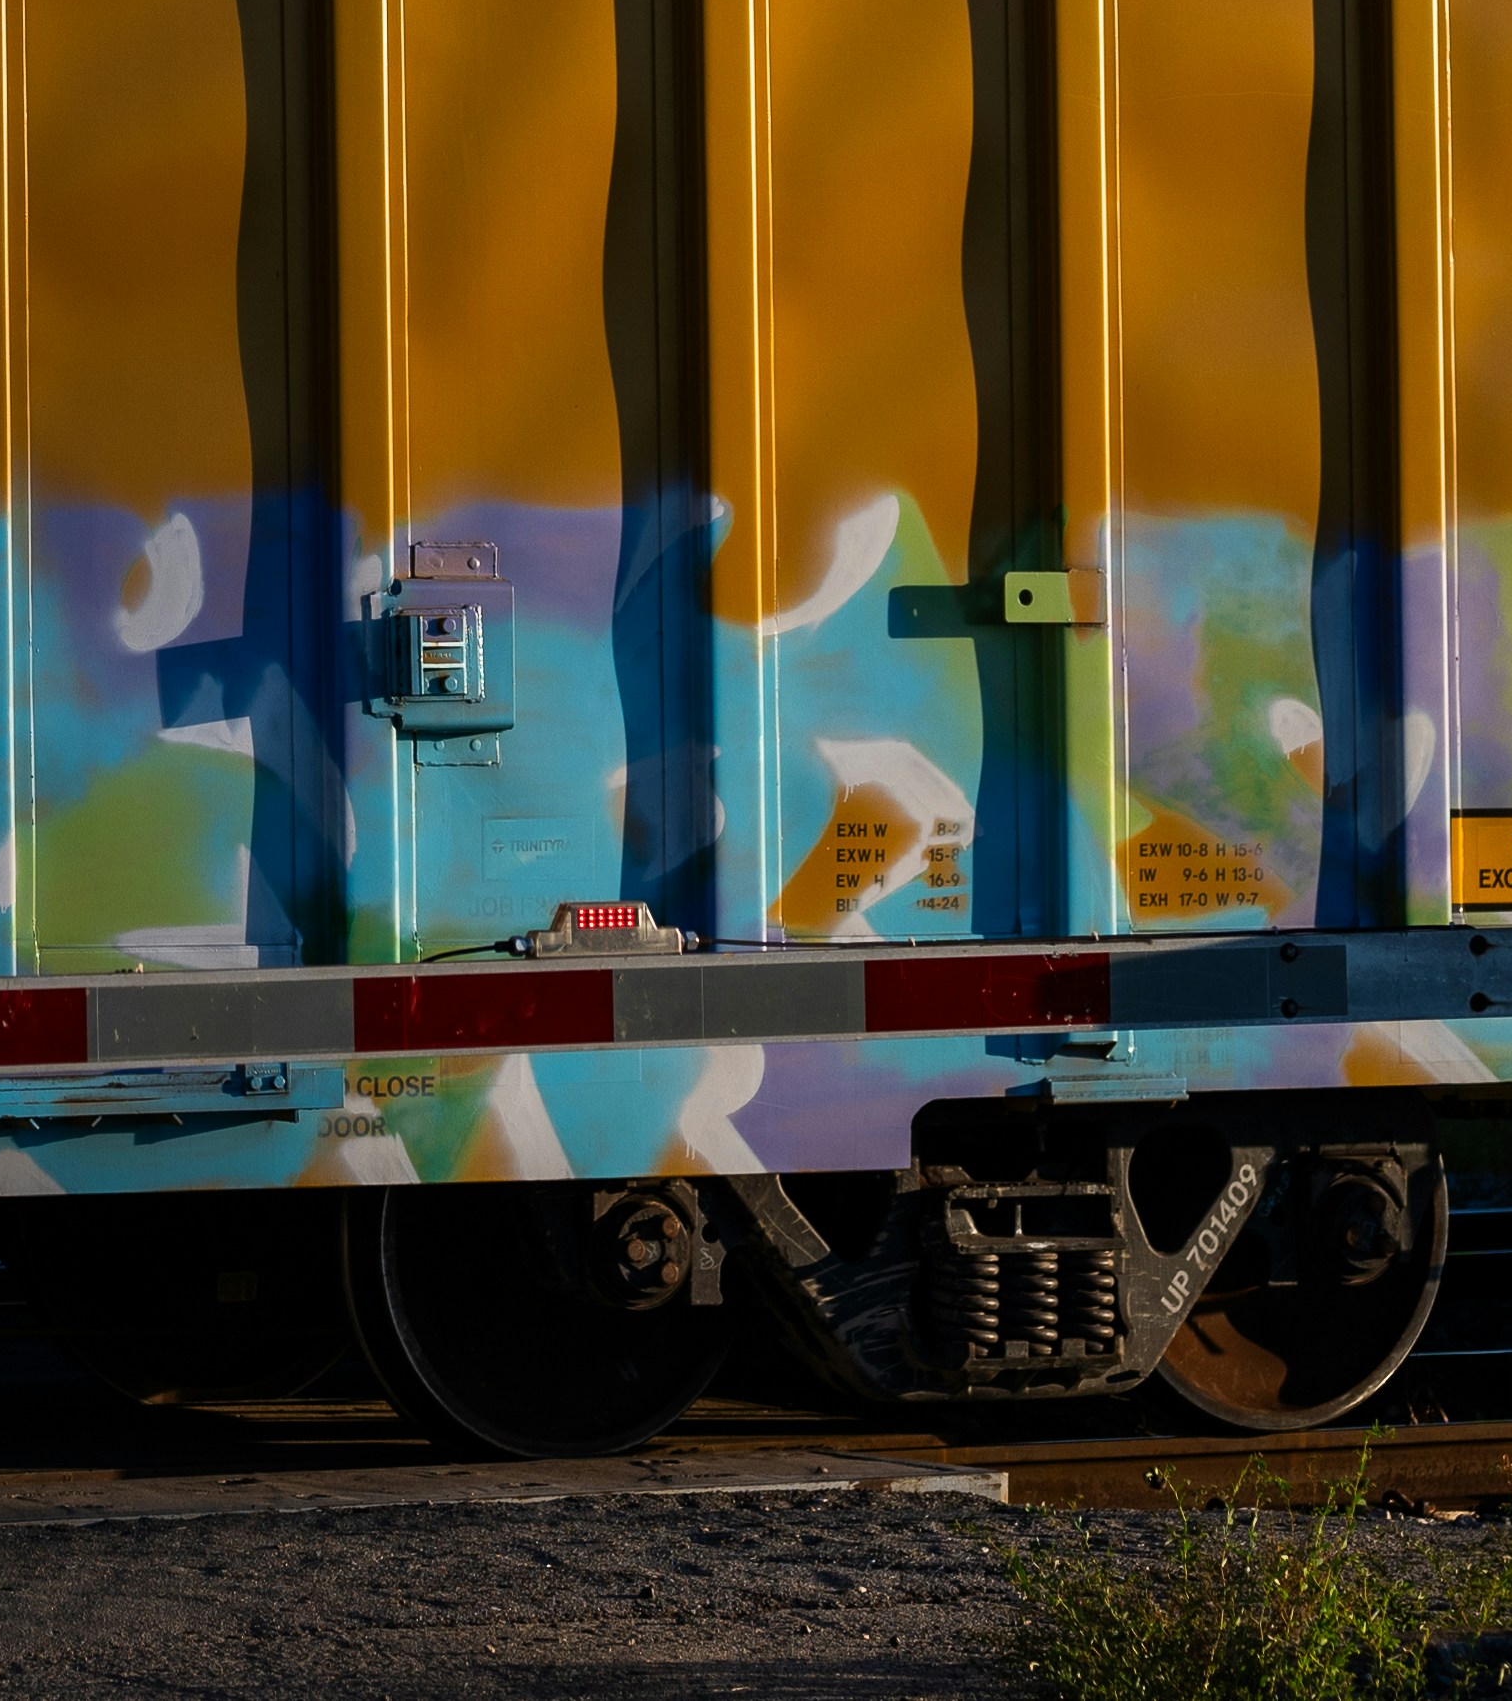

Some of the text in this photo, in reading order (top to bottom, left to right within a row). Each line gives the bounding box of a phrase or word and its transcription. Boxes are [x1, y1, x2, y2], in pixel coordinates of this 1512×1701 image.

[836, 823, 868, 838] EXH
[873, 823, 888, 838] W
[836, 849, 872, 863] EXW
[875, 849, 886, 863] H
[1139, 843, 1174, 858] EXW
[1176, 843, 1208, 858] 10-8
[1216, 843, 1226, 857] H
[836, 874, 860, 888] EW
[929, 873, 961, 887] 16-9
[1139, 867, 1264, 882] IW 9-6 H 13-0
[1139, 892, 1259, 907] EXH 17-0 W 9-7
[357, 1076, 435, 1097] CLOSE
[318, 1115, 386, 1138] DOOR
[1160, 1164, 1258, 1314] UP 701409
